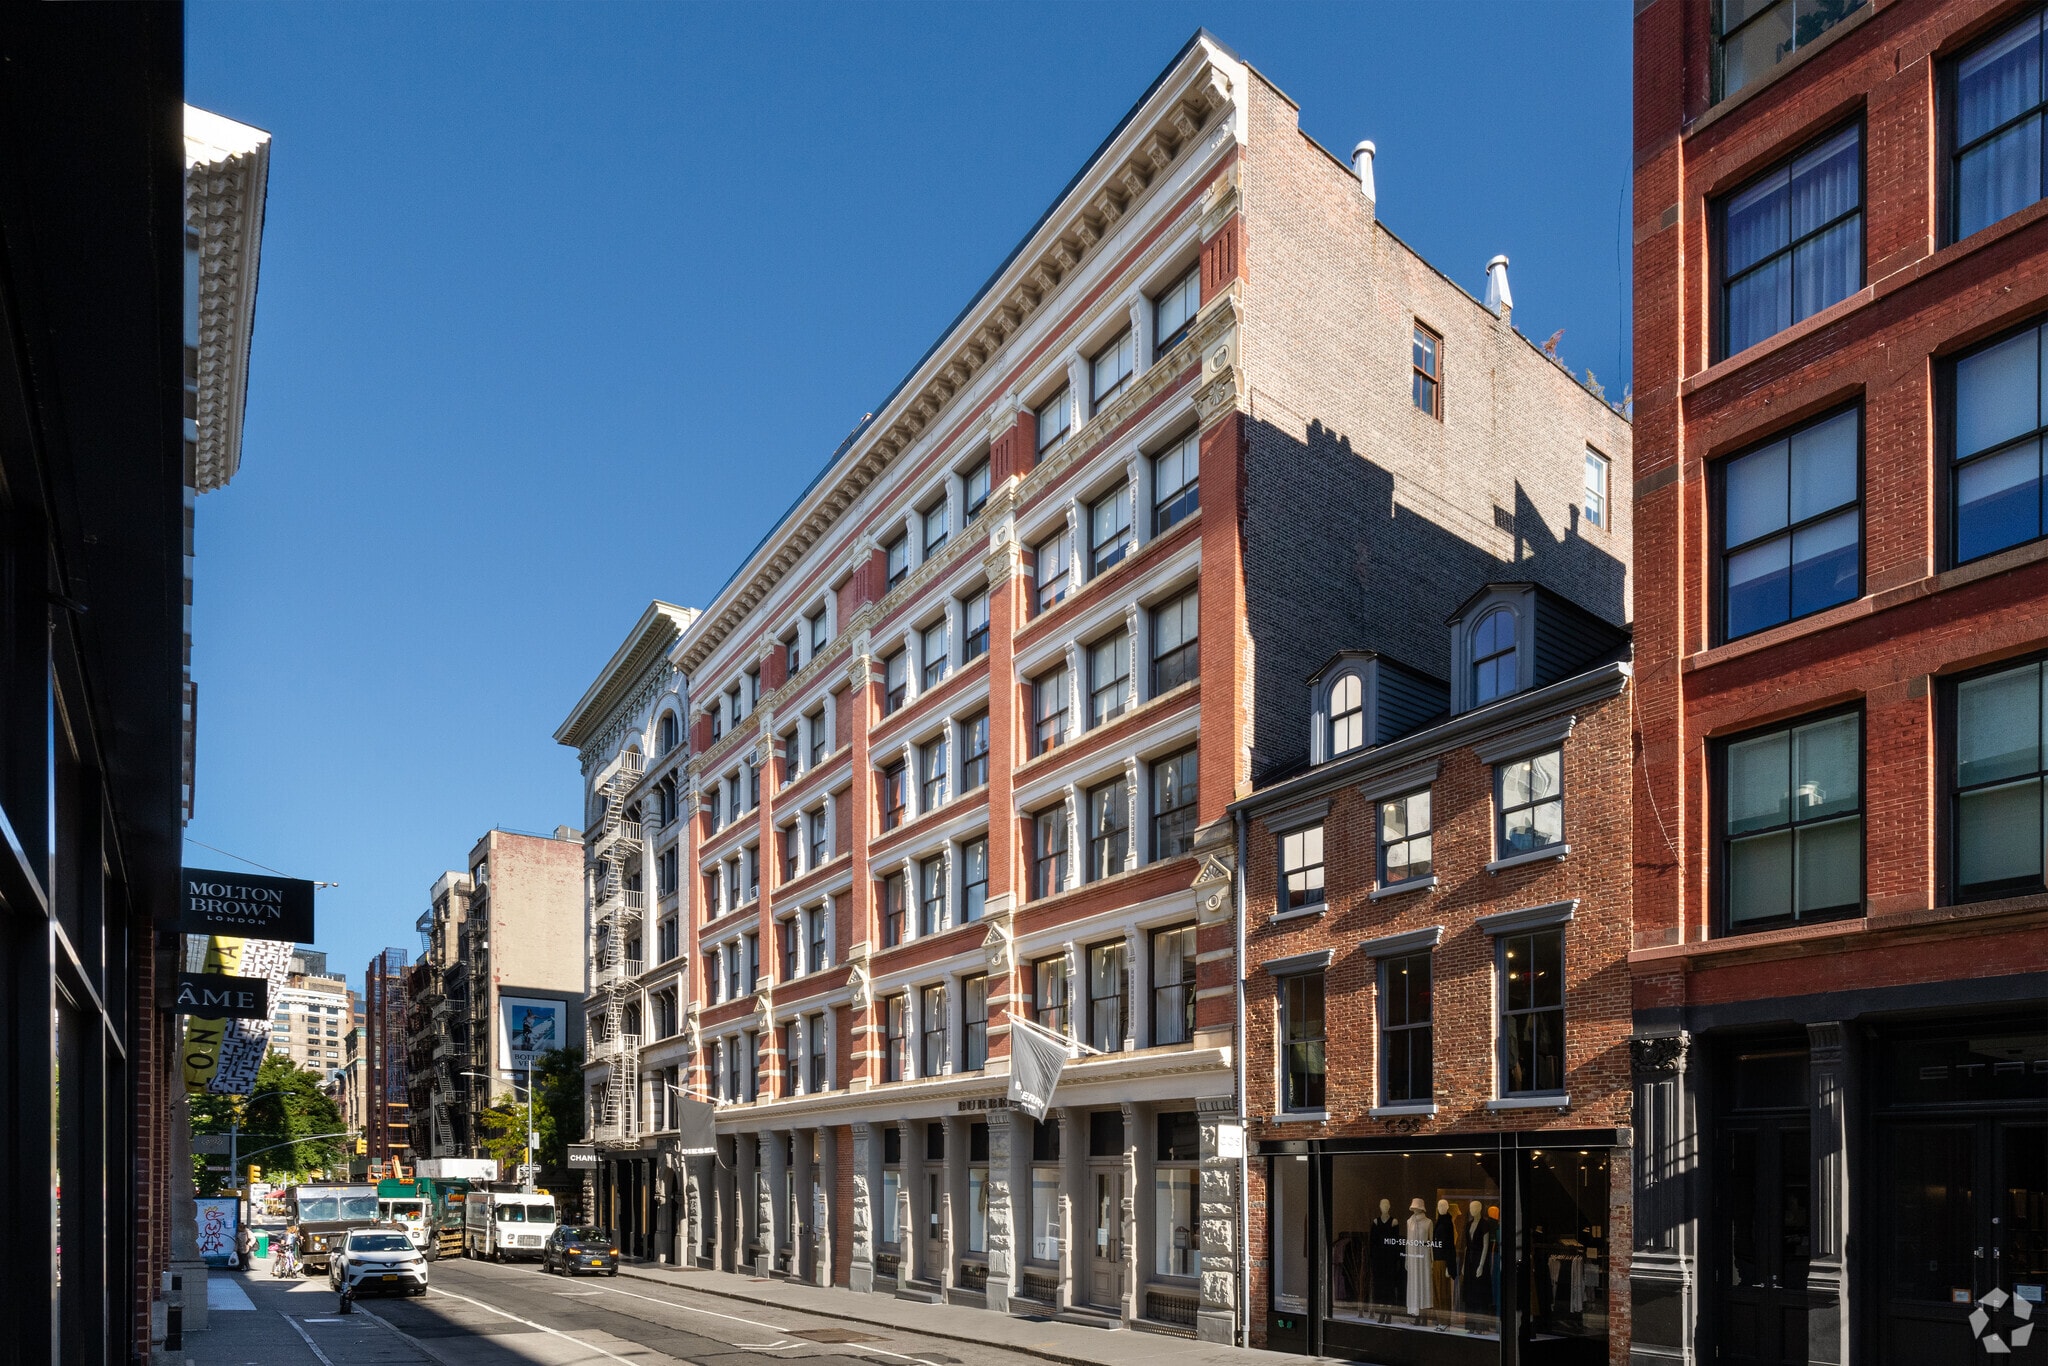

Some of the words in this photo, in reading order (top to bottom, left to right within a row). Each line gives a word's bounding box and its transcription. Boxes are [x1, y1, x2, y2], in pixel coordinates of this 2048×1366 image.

[189, 881, 283, 904] MOLTON
[190, 897, 281, 919] BROWN
[207, 915, 266, 925] LONDON
[957, 1097, 1014, 1111] BURBE
[1385, 1118, 1420, 1133] COS
[681, 1147, 717, 1155] DIESEL
[569, 1154, 603, 1162] CHANEL
[1037, 1242, 1046, 1255] 17
[1426, 1240, 1443, 1248] SALE
